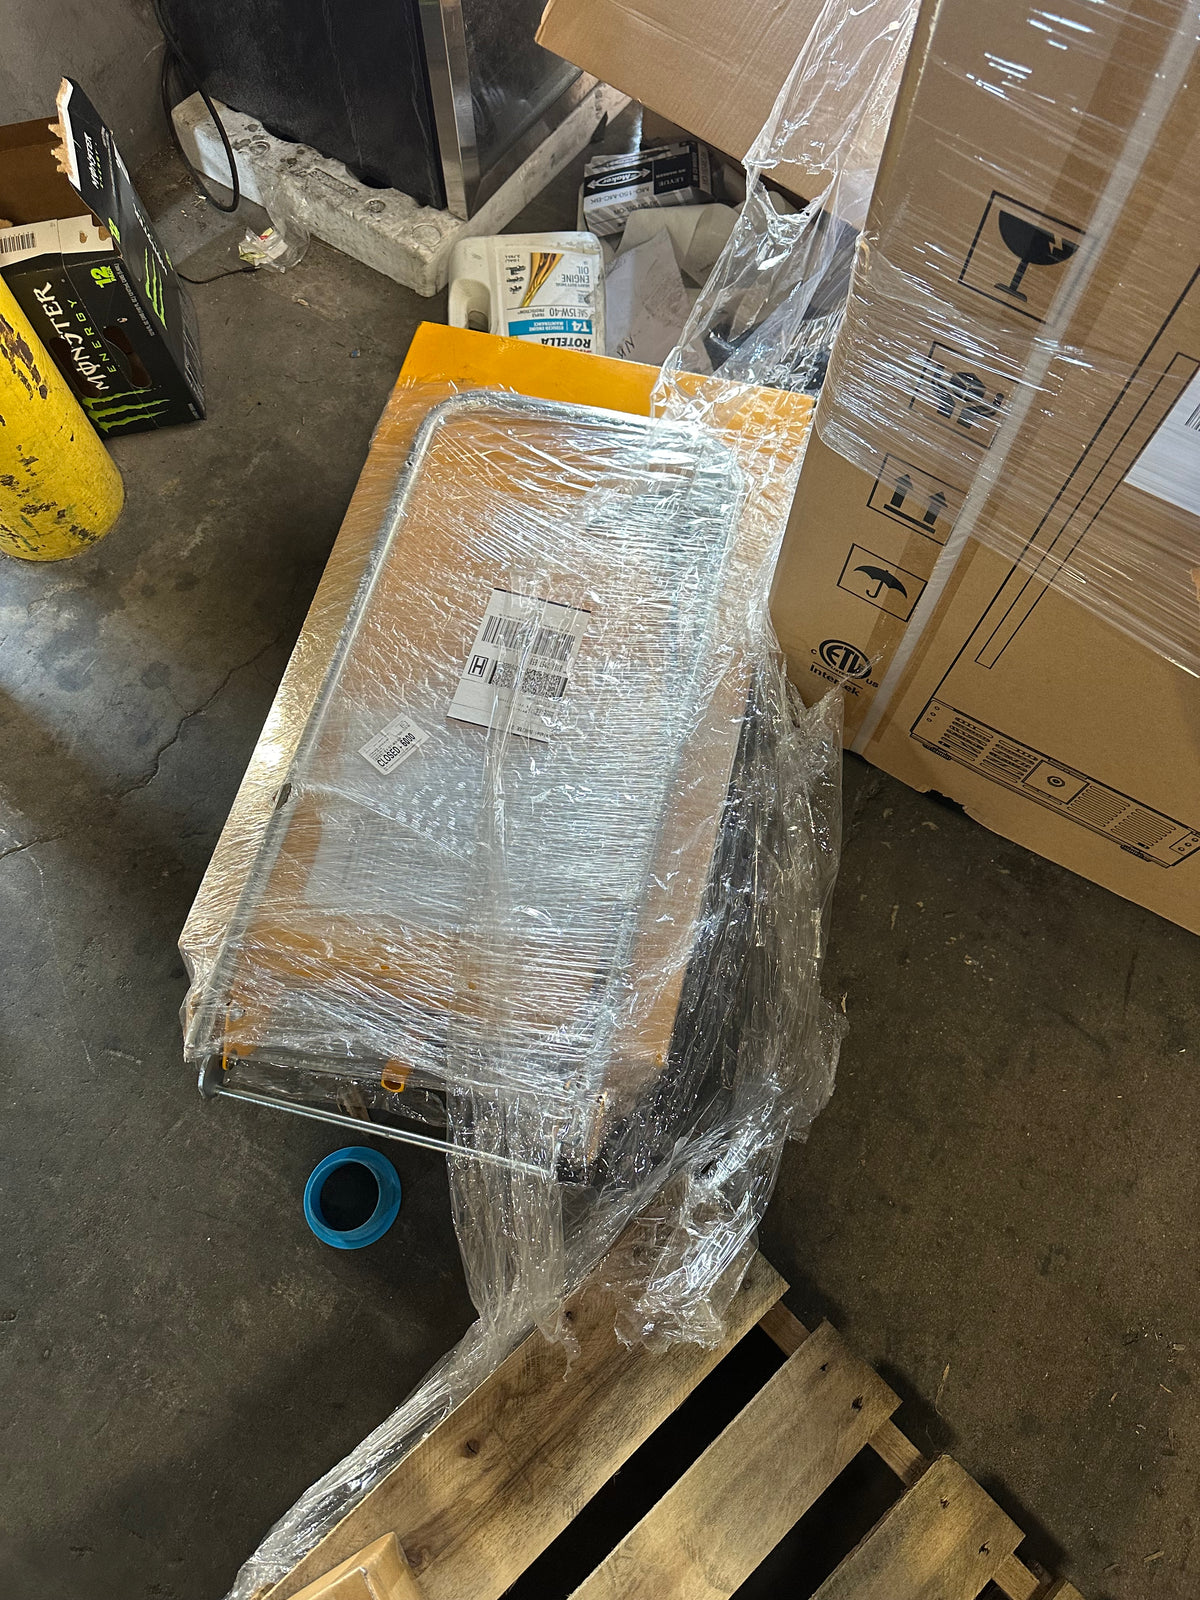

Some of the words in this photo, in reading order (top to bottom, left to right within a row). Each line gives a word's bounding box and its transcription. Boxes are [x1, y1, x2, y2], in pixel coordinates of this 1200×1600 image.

[90, 265, 112, 289] 12
[561, 274, 590, 283] ENGINE
[577, 265, 589, 274] OIL
[549, 307, 577, 317] 15W-40
[571, 321, 590, 332] T4
[33, 281, 110, 391] MONSTER
[67, 299, 116, 373] ENERGY
[541, 337, 591, 349] ROTELLA
[471, 657, 485, 675] H
[809, 664, 860, 697] Interek
[376, 745, 401, 767] CLOSED
[400, 732, 416, 747] 6000
